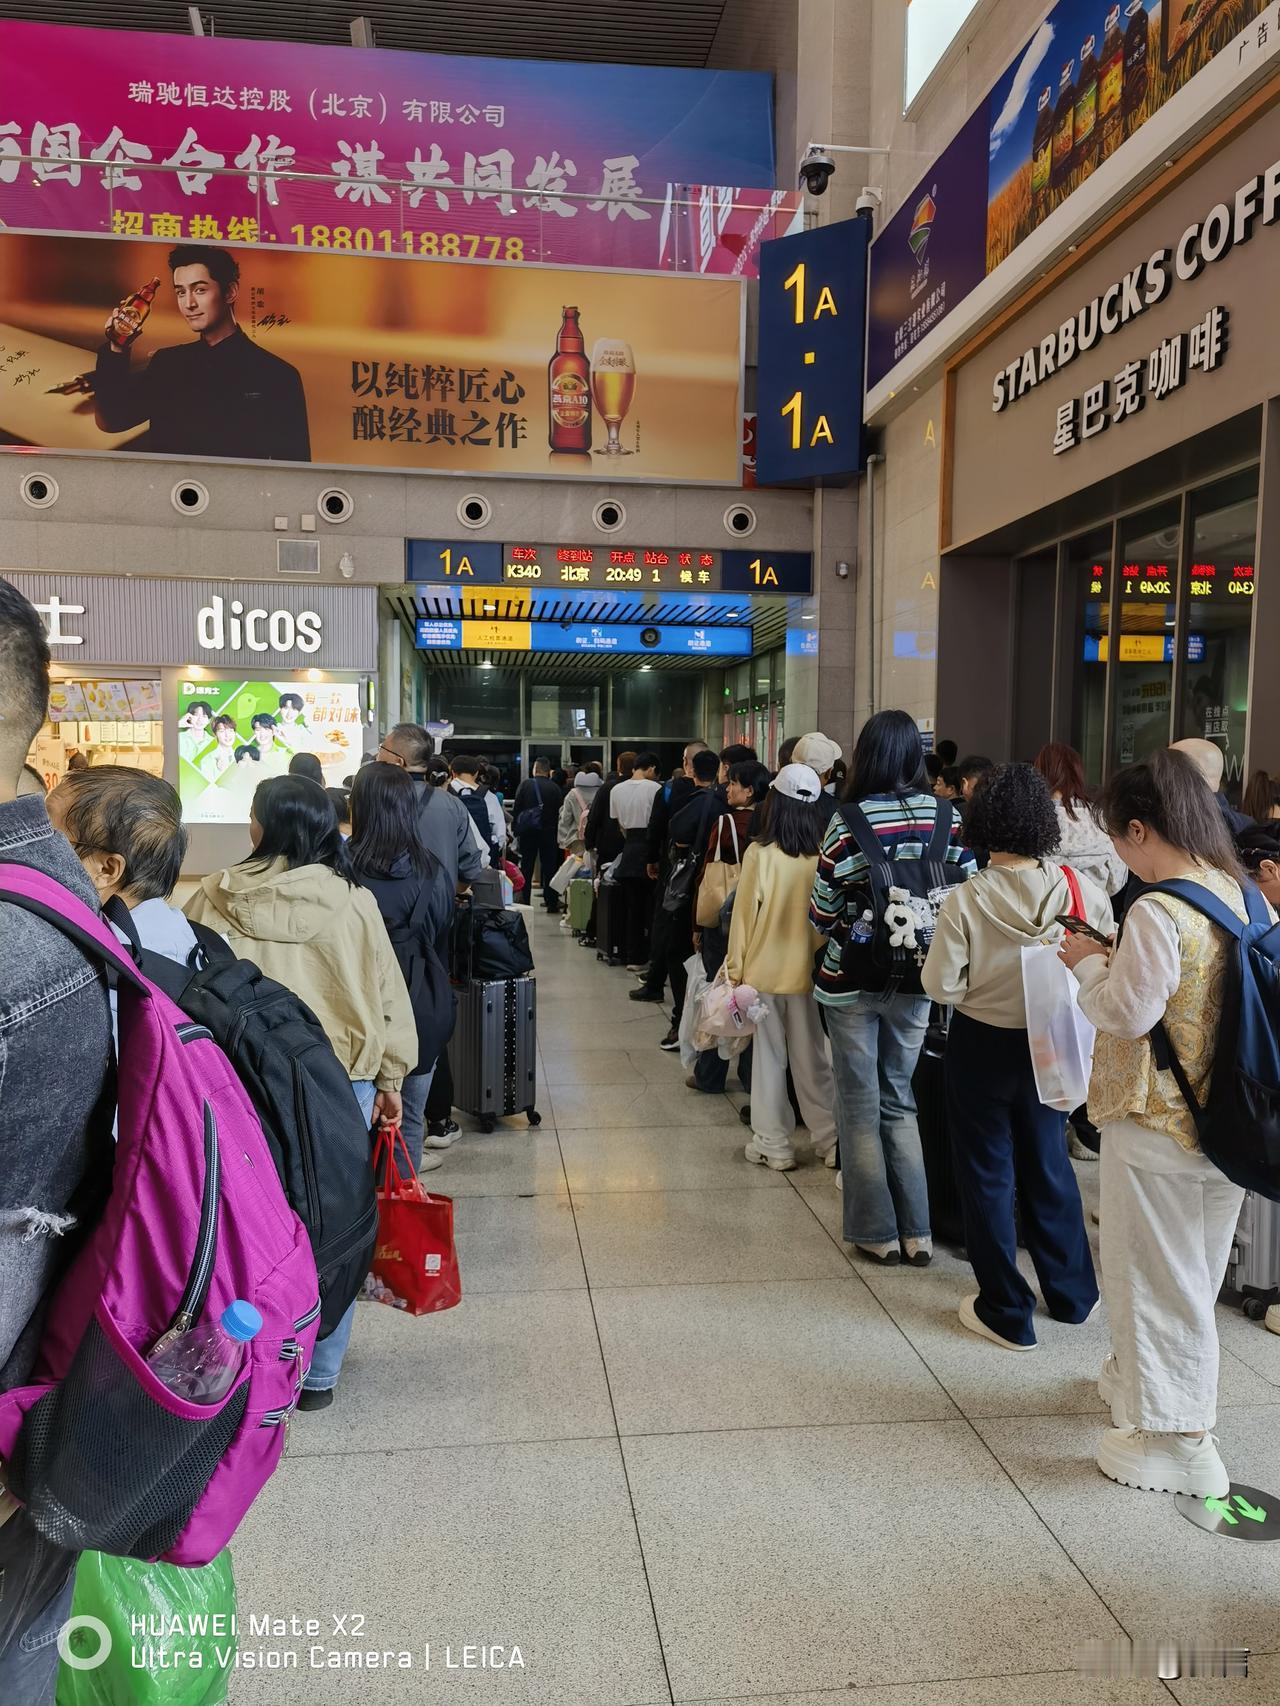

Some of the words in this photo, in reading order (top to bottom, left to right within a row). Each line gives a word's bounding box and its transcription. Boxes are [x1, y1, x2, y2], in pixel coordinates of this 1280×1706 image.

[331, 139, 653, 222] 谋共同发展
[290, 223, 524, 263] 18801188778
[784, 262, 838, 324] 1A
[991, 249, 1169, 414] STARBUCKS
[351, 360, 526, 405] 以纯粹匠心
[1052, 305, 1227, 457] 星巴克咖啡
[352, 404, 529, 449] 酿经典之作
[780, 391, 835, 450] 1A
[438, 548, 475, 577] 1A
[507, 565, 542, 578] K340
[560, 566, 590, 582] 北京
[606, 568, 642, 582] 20:49
[652, 569, 661, 583] 1
[512, 547, 537, 560] 车次
[557, 549, 593, 562] 终到站
[611, 551, 636, 563] 开点
[644, 552, 669, 565] 站台
[749, 558, 779, 585] 1A
[35, 596, 85, 645] 士
[197, 595, 322, 653] dicos
